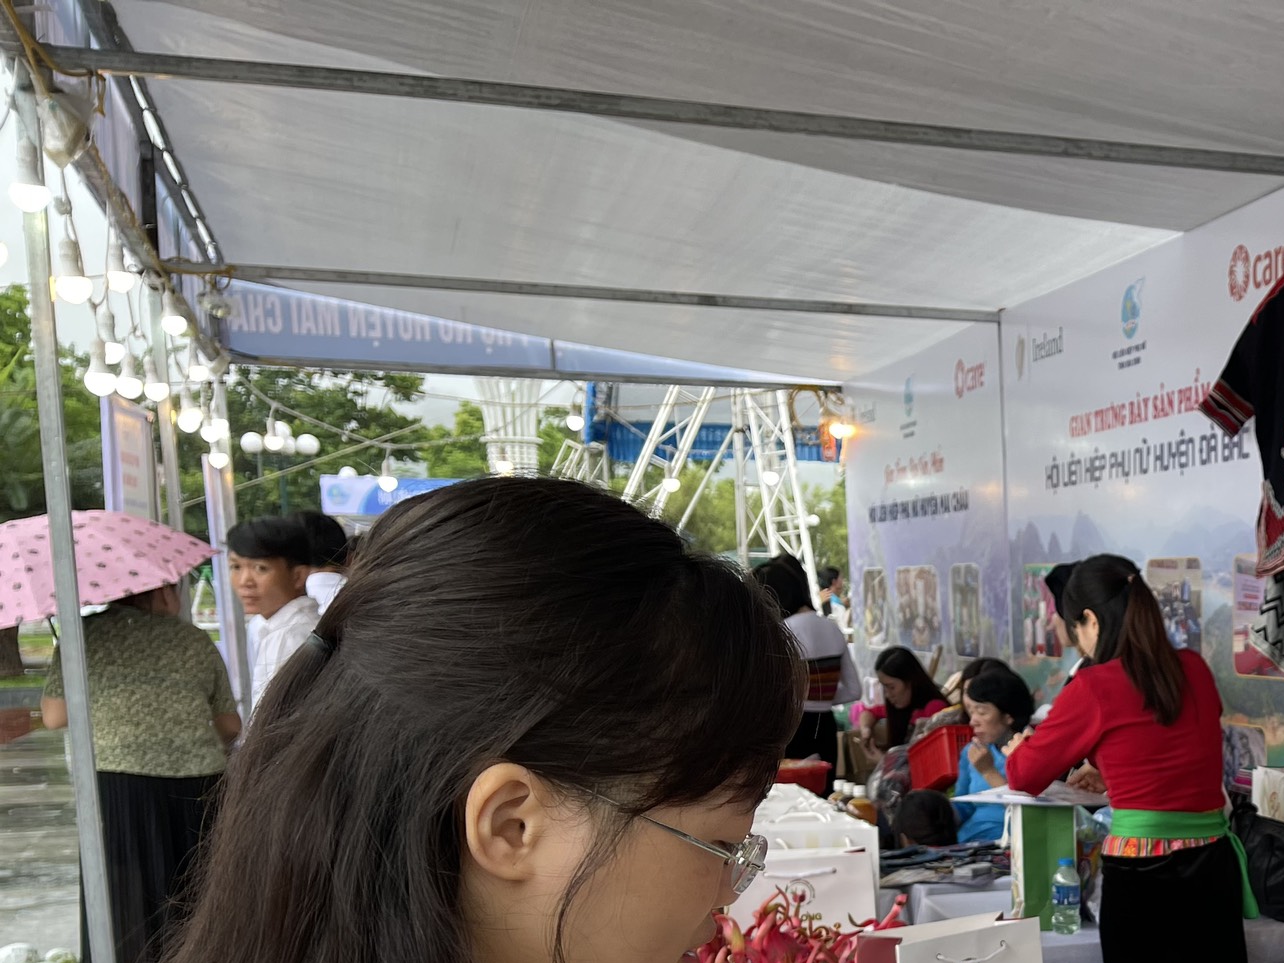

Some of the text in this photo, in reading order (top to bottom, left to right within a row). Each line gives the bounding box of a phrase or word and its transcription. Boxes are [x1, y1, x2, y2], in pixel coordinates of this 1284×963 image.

[1032, 327, 1063, 362] Ireland
[965, 363, 985, 392] care
[1069, 414, 1091, 438] GIAN
[1129, 393, 1151, 425] BÀY
[1152, 382, 1175, 421] SẢN
[1045, 456, 1060, 494] HỘI
[1063, 452, 1082, 488] LIÊN
[1109, 450, 1131, 483] PHỤ
[1153, 429, 1195, 476] HUYỆN
